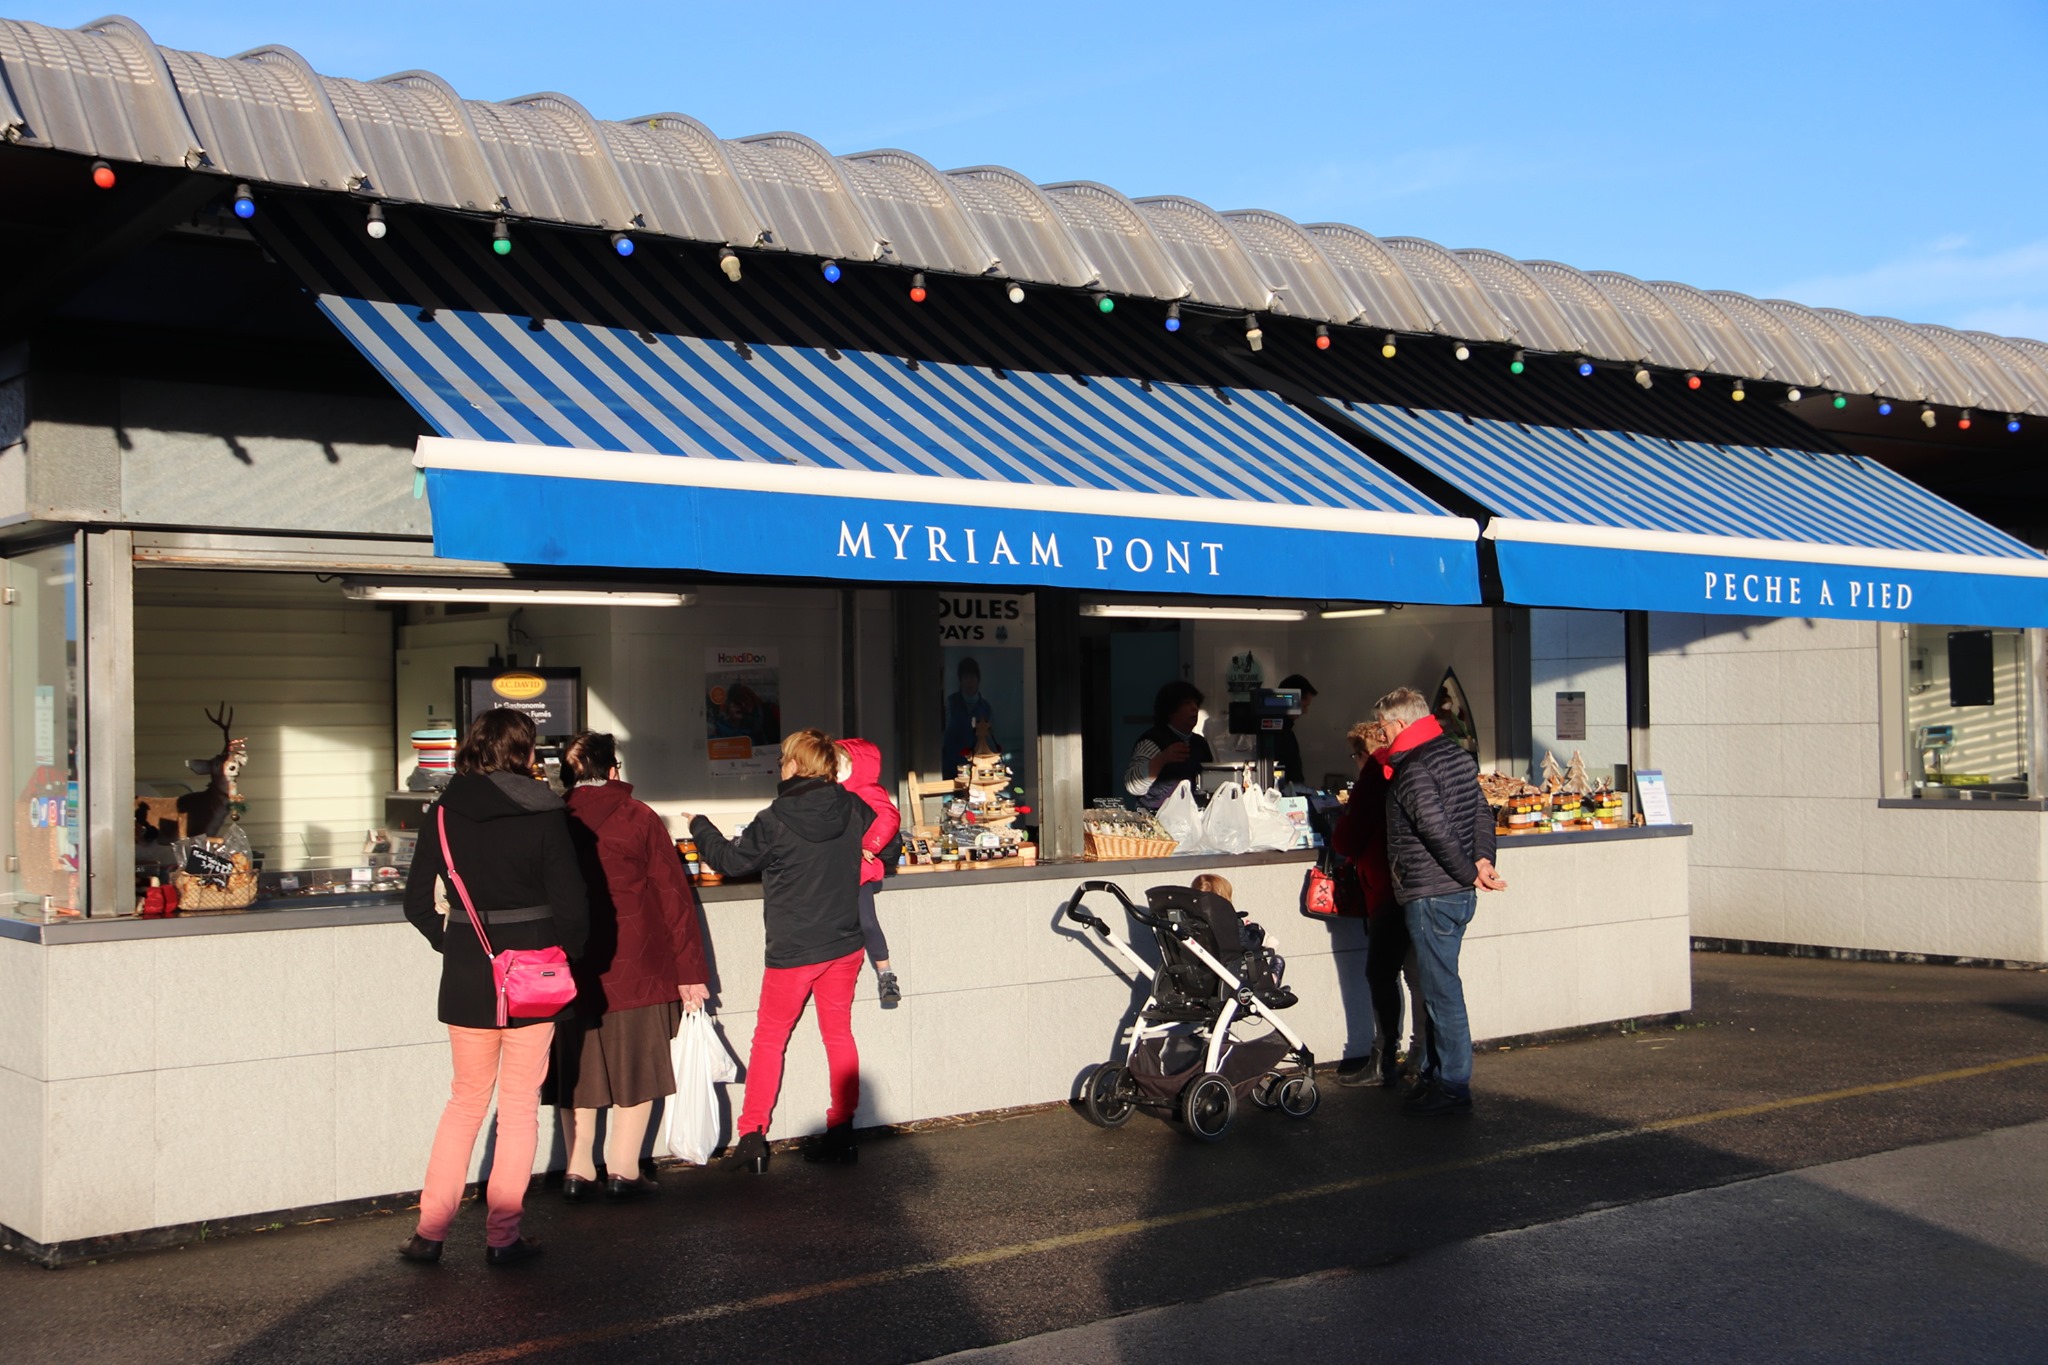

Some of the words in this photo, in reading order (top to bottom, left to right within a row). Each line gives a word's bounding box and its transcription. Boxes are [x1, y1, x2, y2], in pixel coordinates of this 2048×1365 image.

[837, 520, 1063, 568] MYRIAM
[1093, 536, 1224, 576] PONT
[1704, 571, 1801, 604] PECHE
[1819, 579, 1834, 606] A
[1849, 581, 1912, 610] PIED
[718, 651, 767, 663] HandiDon
